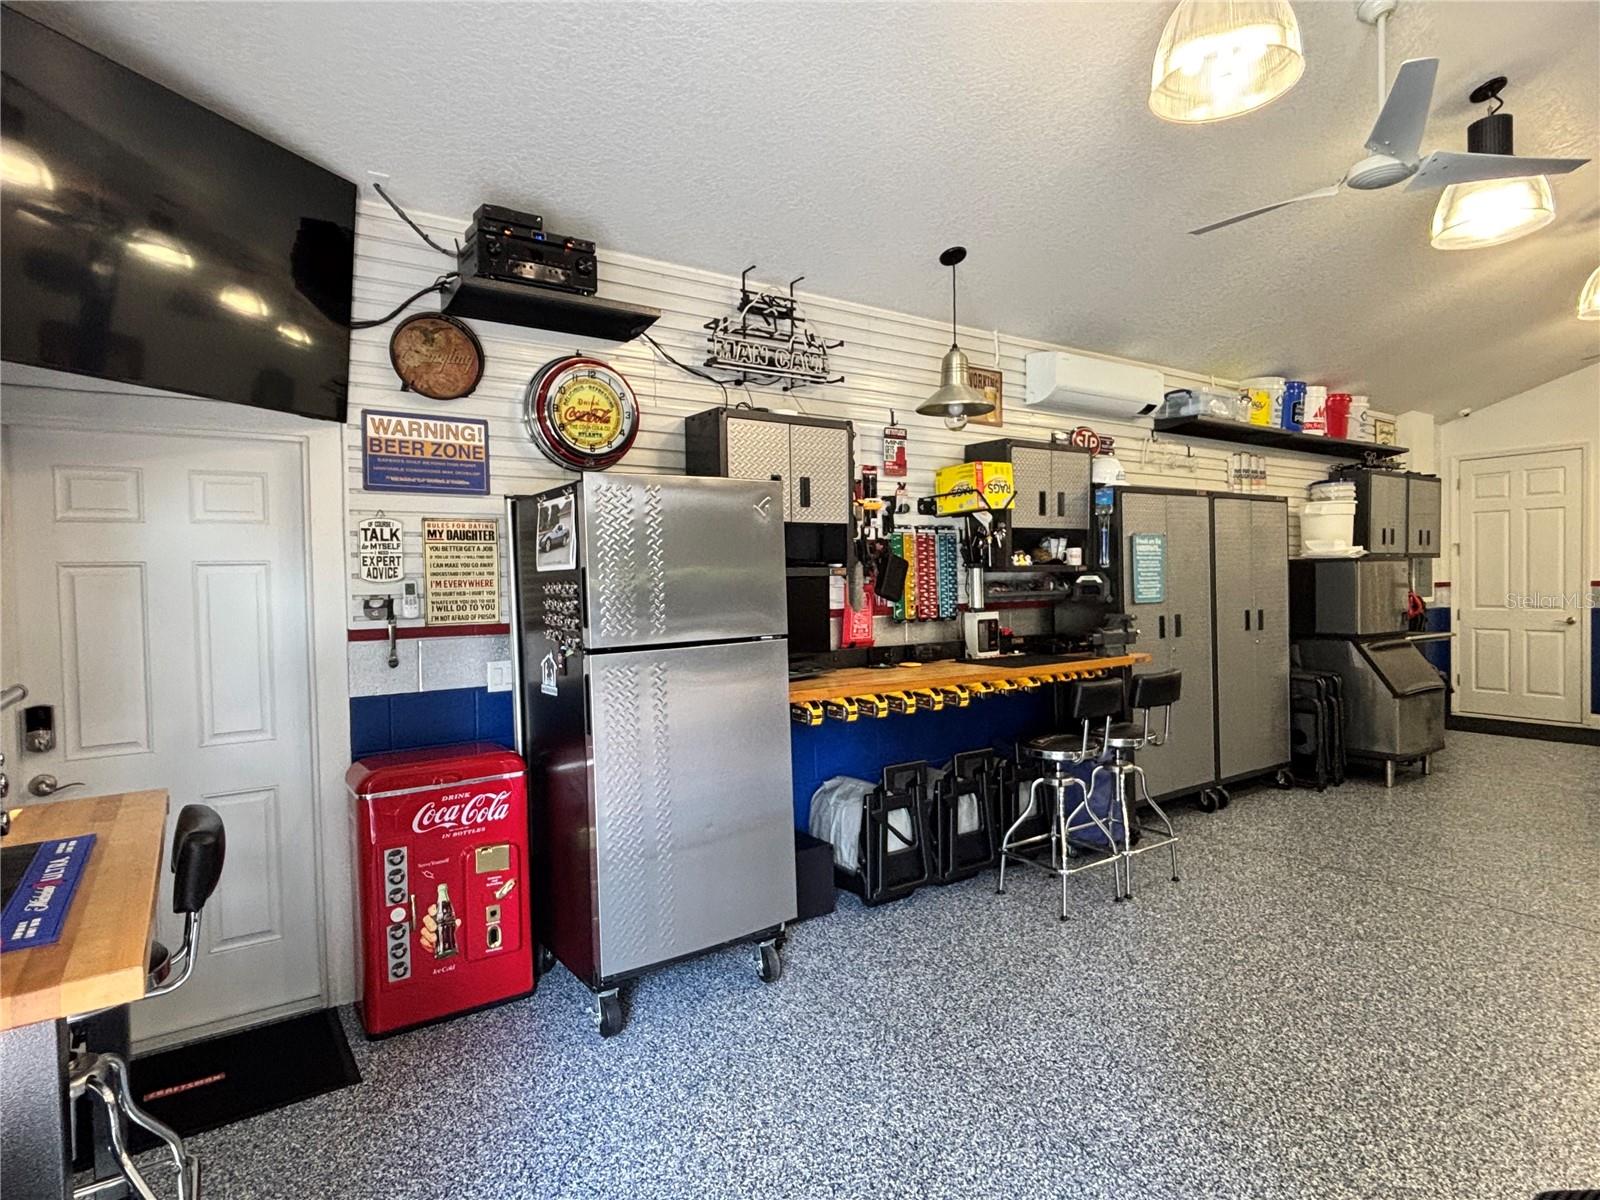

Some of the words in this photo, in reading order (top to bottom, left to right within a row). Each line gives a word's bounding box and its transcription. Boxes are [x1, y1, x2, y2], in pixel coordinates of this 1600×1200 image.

[401, 348, 474, 375] ngling
[572, 374, 578, 382] 11
[587, 370, 597, 379] 12
[558, 385, 566, 395] 10
[619, 392, 626, 401] 2
[553, 403, 559, 412] 9
[625, 411, 631, 420] 3
[370, 417, 483, 443] WARNING!
[558, 422, 565, 432] 8
[619, 428, 625, 437] 4
[571, 437, 578, 446] 7
[1076, 430, 1098, 448] STP
[370, 437, 425, 456] BEER
[430, 442, 484, 460] ZONE
[589, 444, 596, 452] 6
[607, 440, 613, 449] 5
[987, 483, 1011, 494] RAGS
[361, 528, 401, 541] TALK
[427, 529, 444, 538] MY
[446, 530, 495, 541] DAUGHTER
[362, 556, 401, 566] EXPERT
[366, 567, 398, 580] ADVICE
[430, 580, 442, 588] I'M
[443, 579, 494, 588] EVERYWHERE
[441, 792, 472, 802] DRINK
[411, 790, 513, 834] Coca-Cola
[452, 827, 486, 838] BOTTLES
[147, 1073, 222, 1100] CRAFTSMAN
